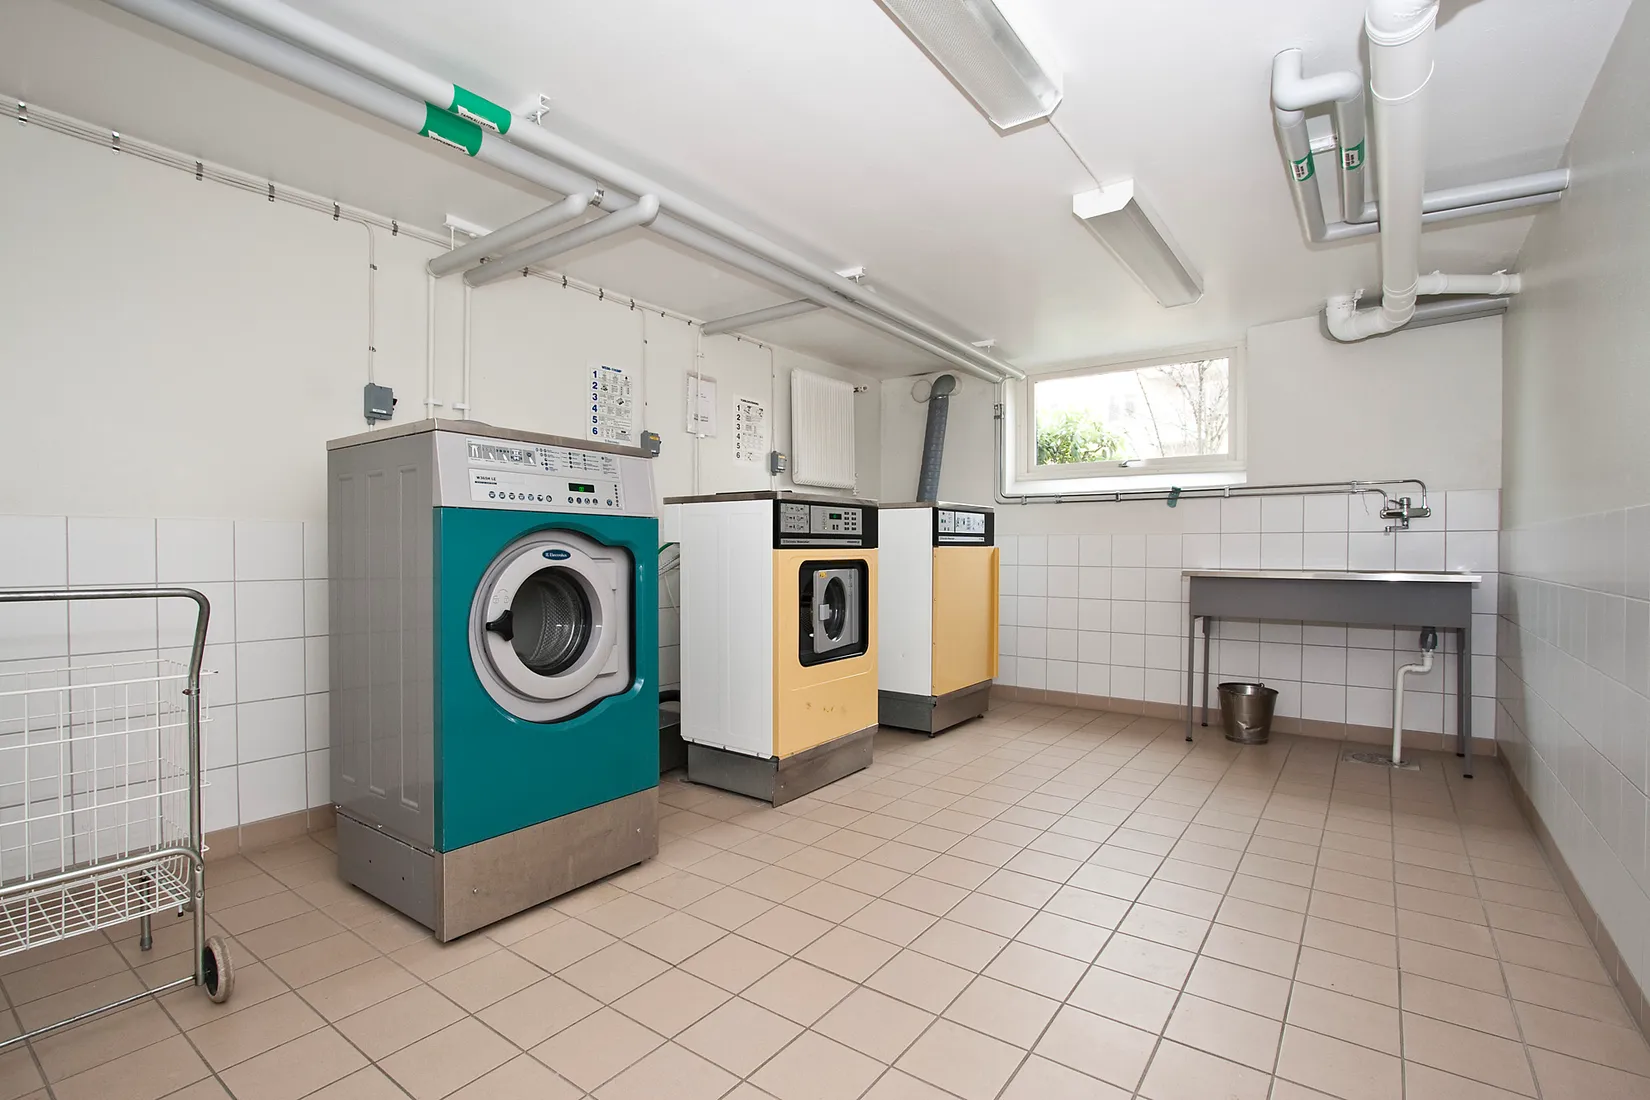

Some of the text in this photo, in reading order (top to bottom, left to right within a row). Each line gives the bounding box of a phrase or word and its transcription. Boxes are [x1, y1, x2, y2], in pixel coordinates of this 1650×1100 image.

[593, 370, 597, 378] 1
[592, 382, 598, 390] 2
[592, 393, 598, 401] 3
[592, 404, 598, 412] 4
[592, 416, 598, 424] 5
[592, 427, 598, 435] 6
